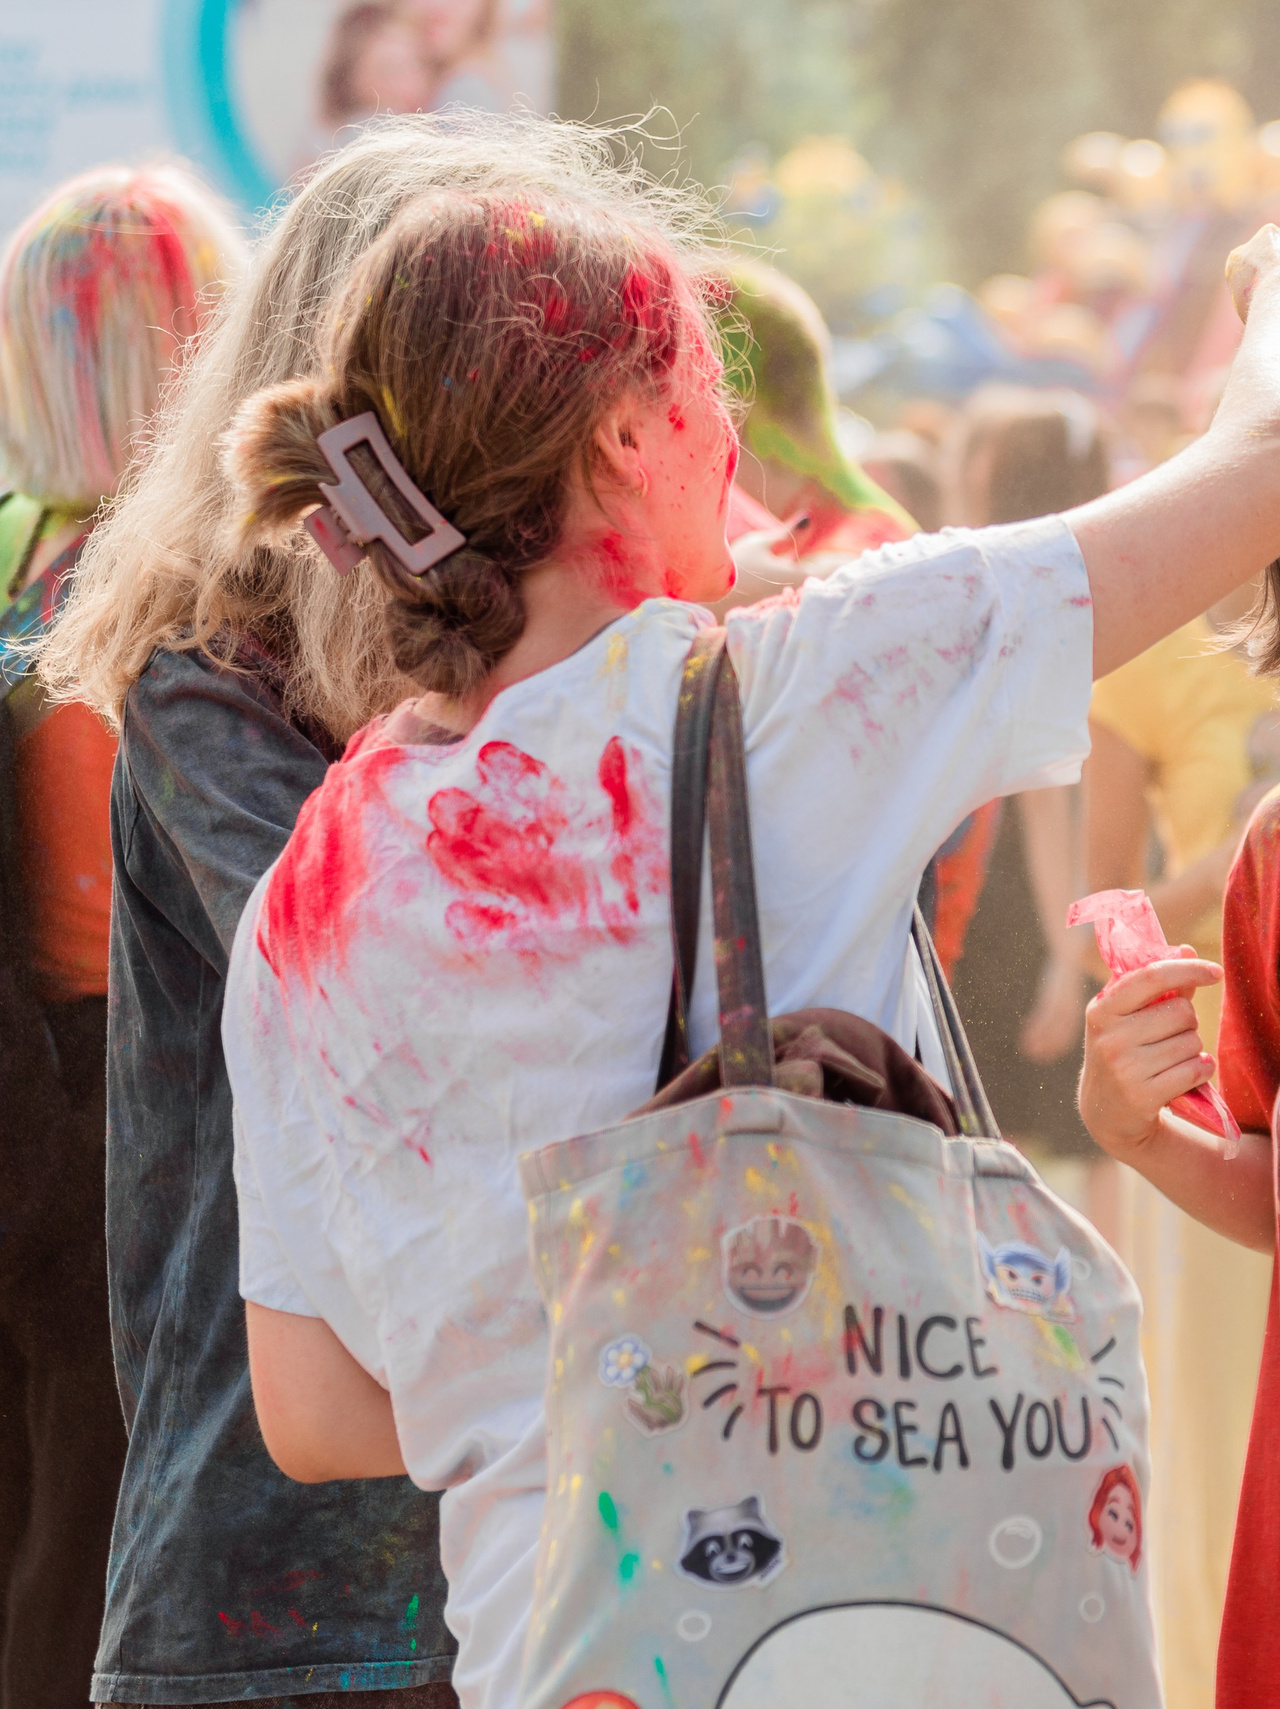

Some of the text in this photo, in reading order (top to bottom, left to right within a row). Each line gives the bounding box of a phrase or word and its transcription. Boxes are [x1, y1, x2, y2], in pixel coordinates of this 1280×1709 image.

[844, 1304, 998, 1379] NICE
[758, 1386, 1093, 1473] TO SEA YOU
